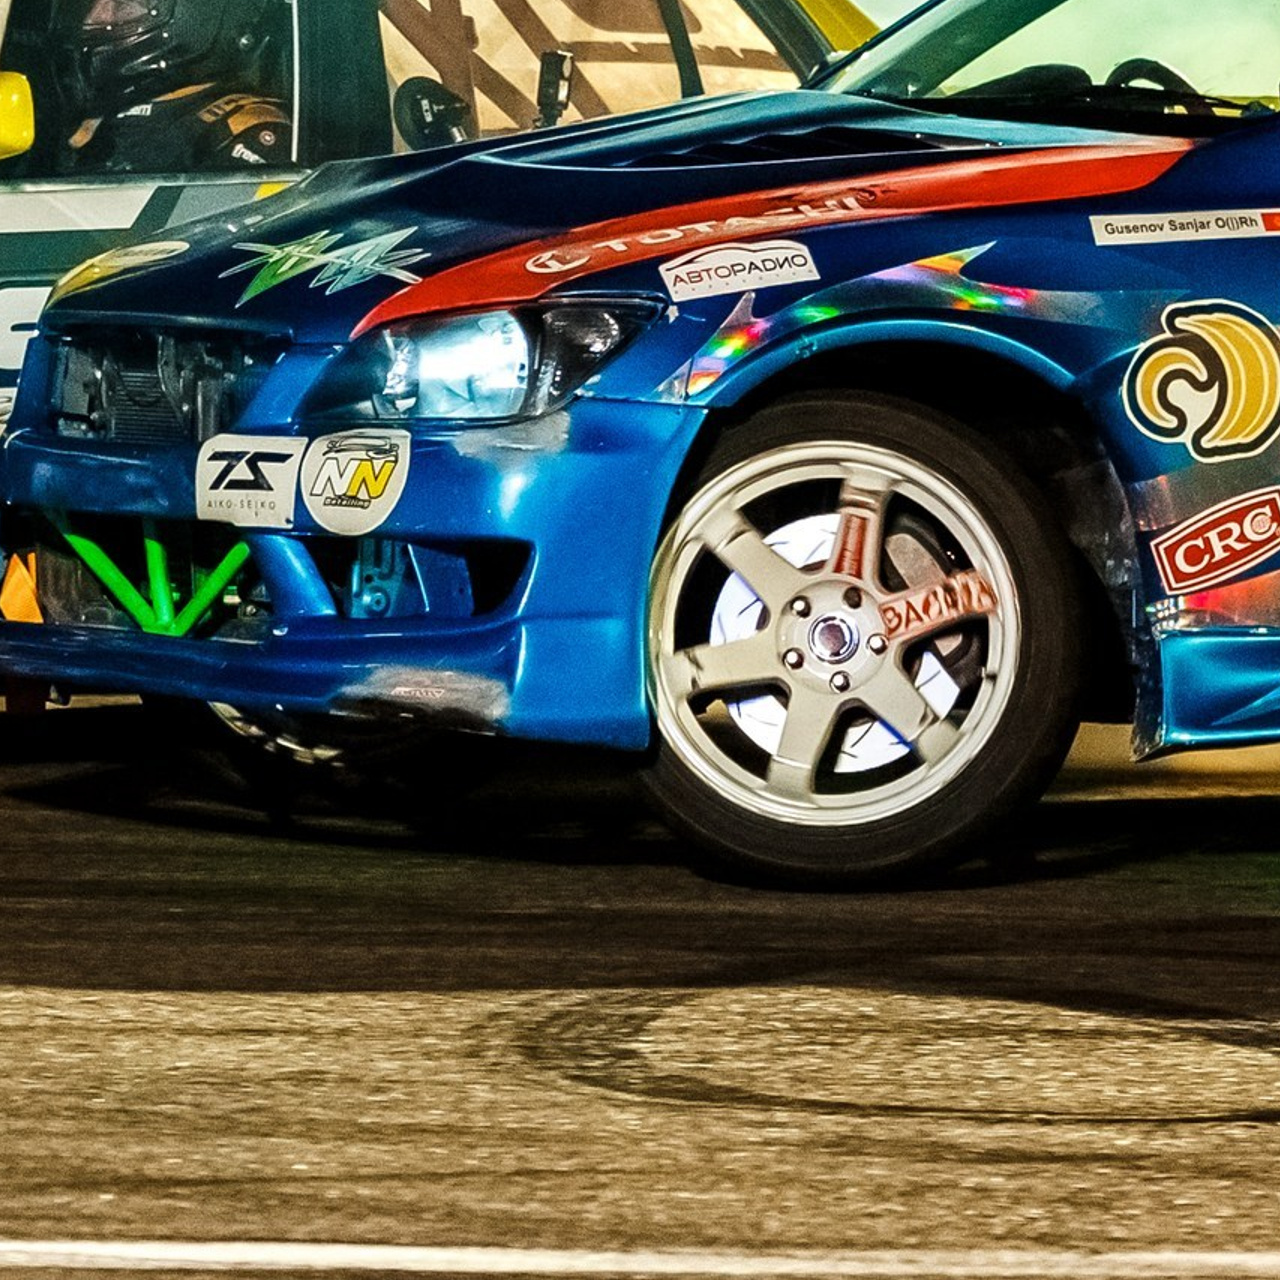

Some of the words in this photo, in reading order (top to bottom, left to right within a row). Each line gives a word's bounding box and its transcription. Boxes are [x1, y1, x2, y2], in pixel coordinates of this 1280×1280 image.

[1104, 222, 1165, 235] Gusenov
[1168, 219, 1211, 233] Sanjar
[672, 253, 808, 288] АВТОРАДИО
[206, 499, 277, 511] AIKO-SEIKO
[1173, 504, 1279, 575] CRC
